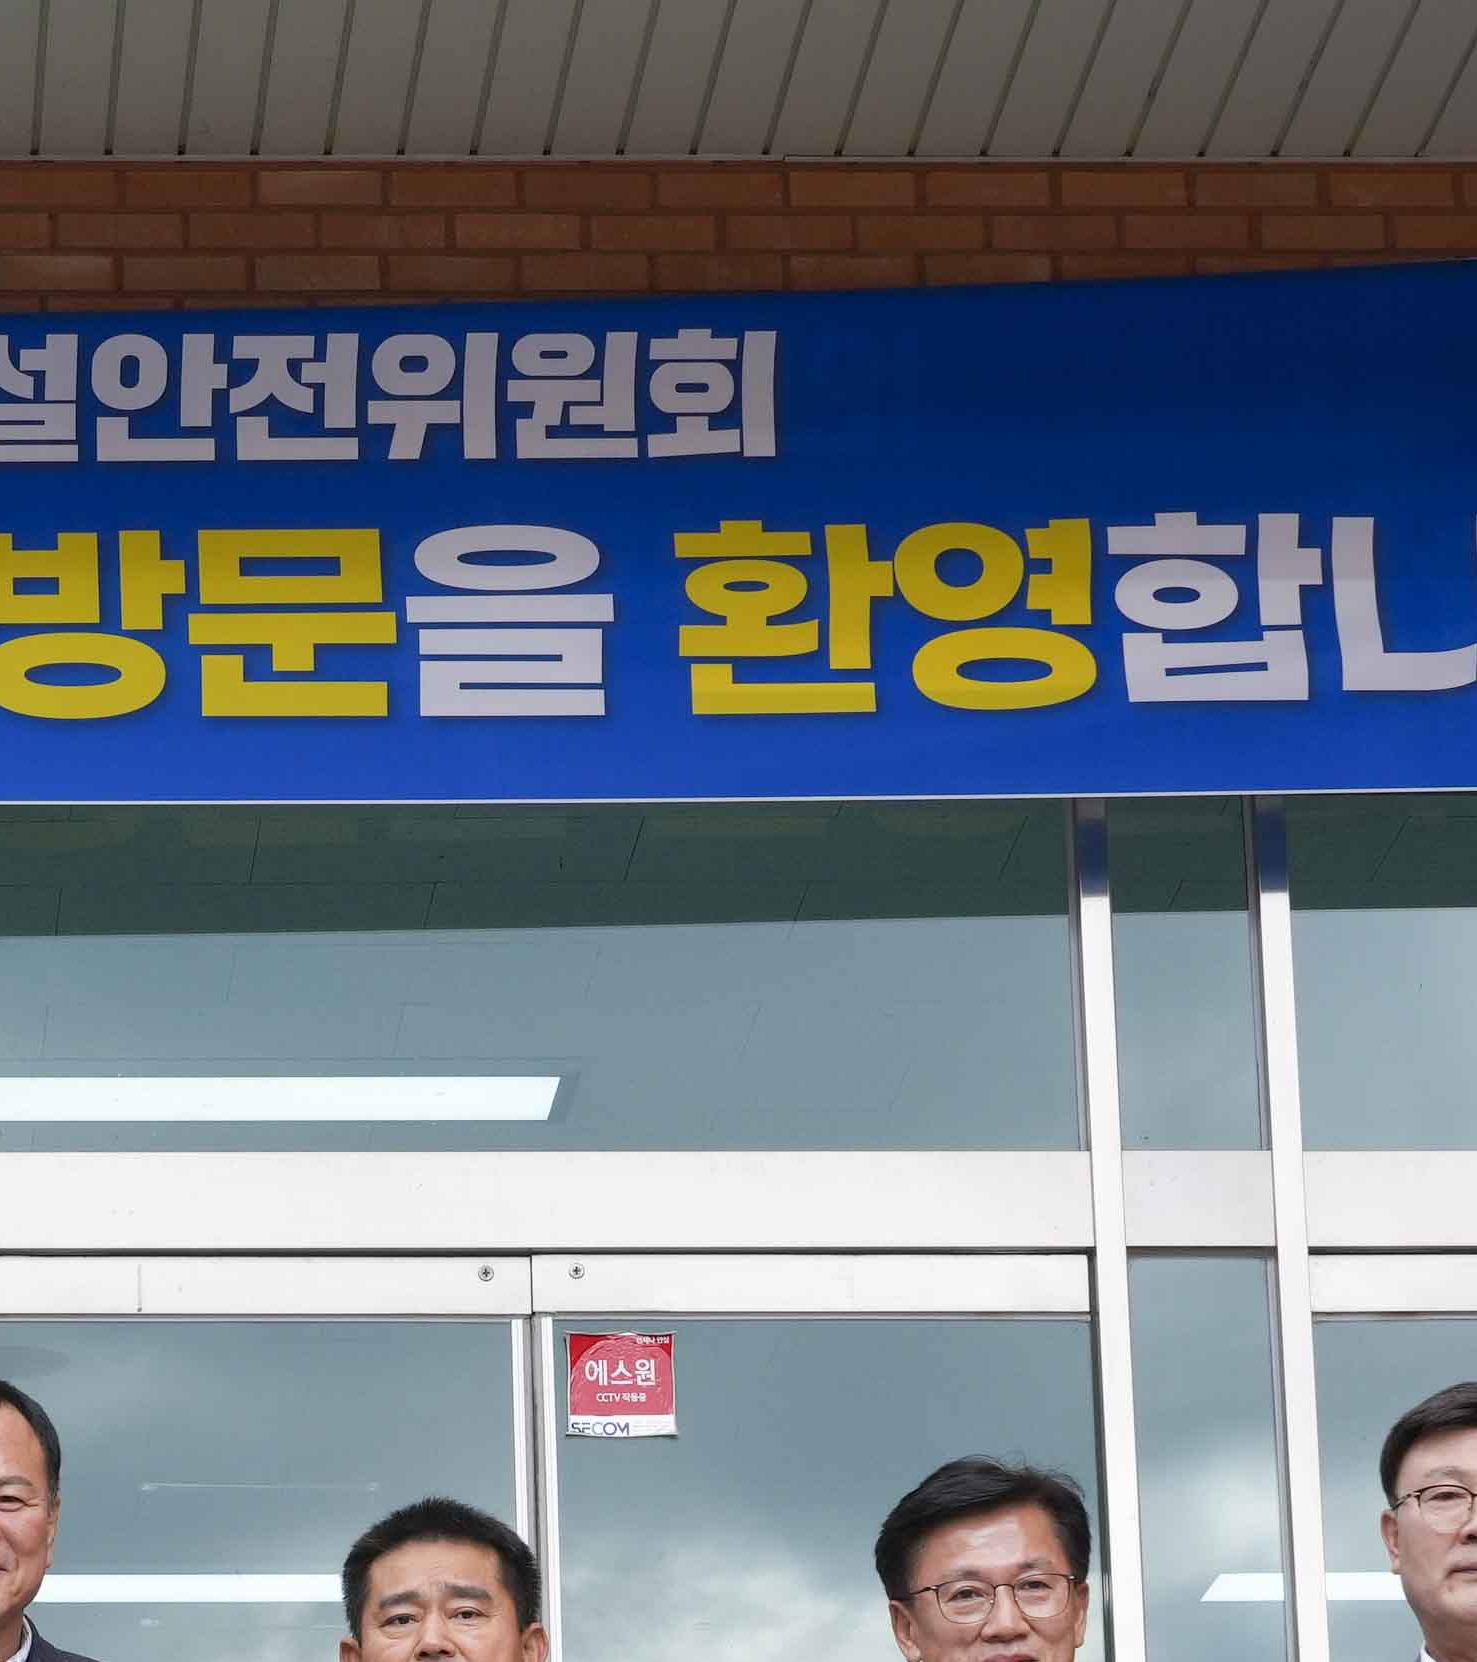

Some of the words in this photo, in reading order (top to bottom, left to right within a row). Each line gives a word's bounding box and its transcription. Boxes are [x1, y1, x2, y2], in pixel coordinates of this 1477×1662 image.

[585, 1359, 656, 1386] 에스원
[596, 1392, 621, 1402] CCTV
[571, 1421, 630, 1436] SECOM
